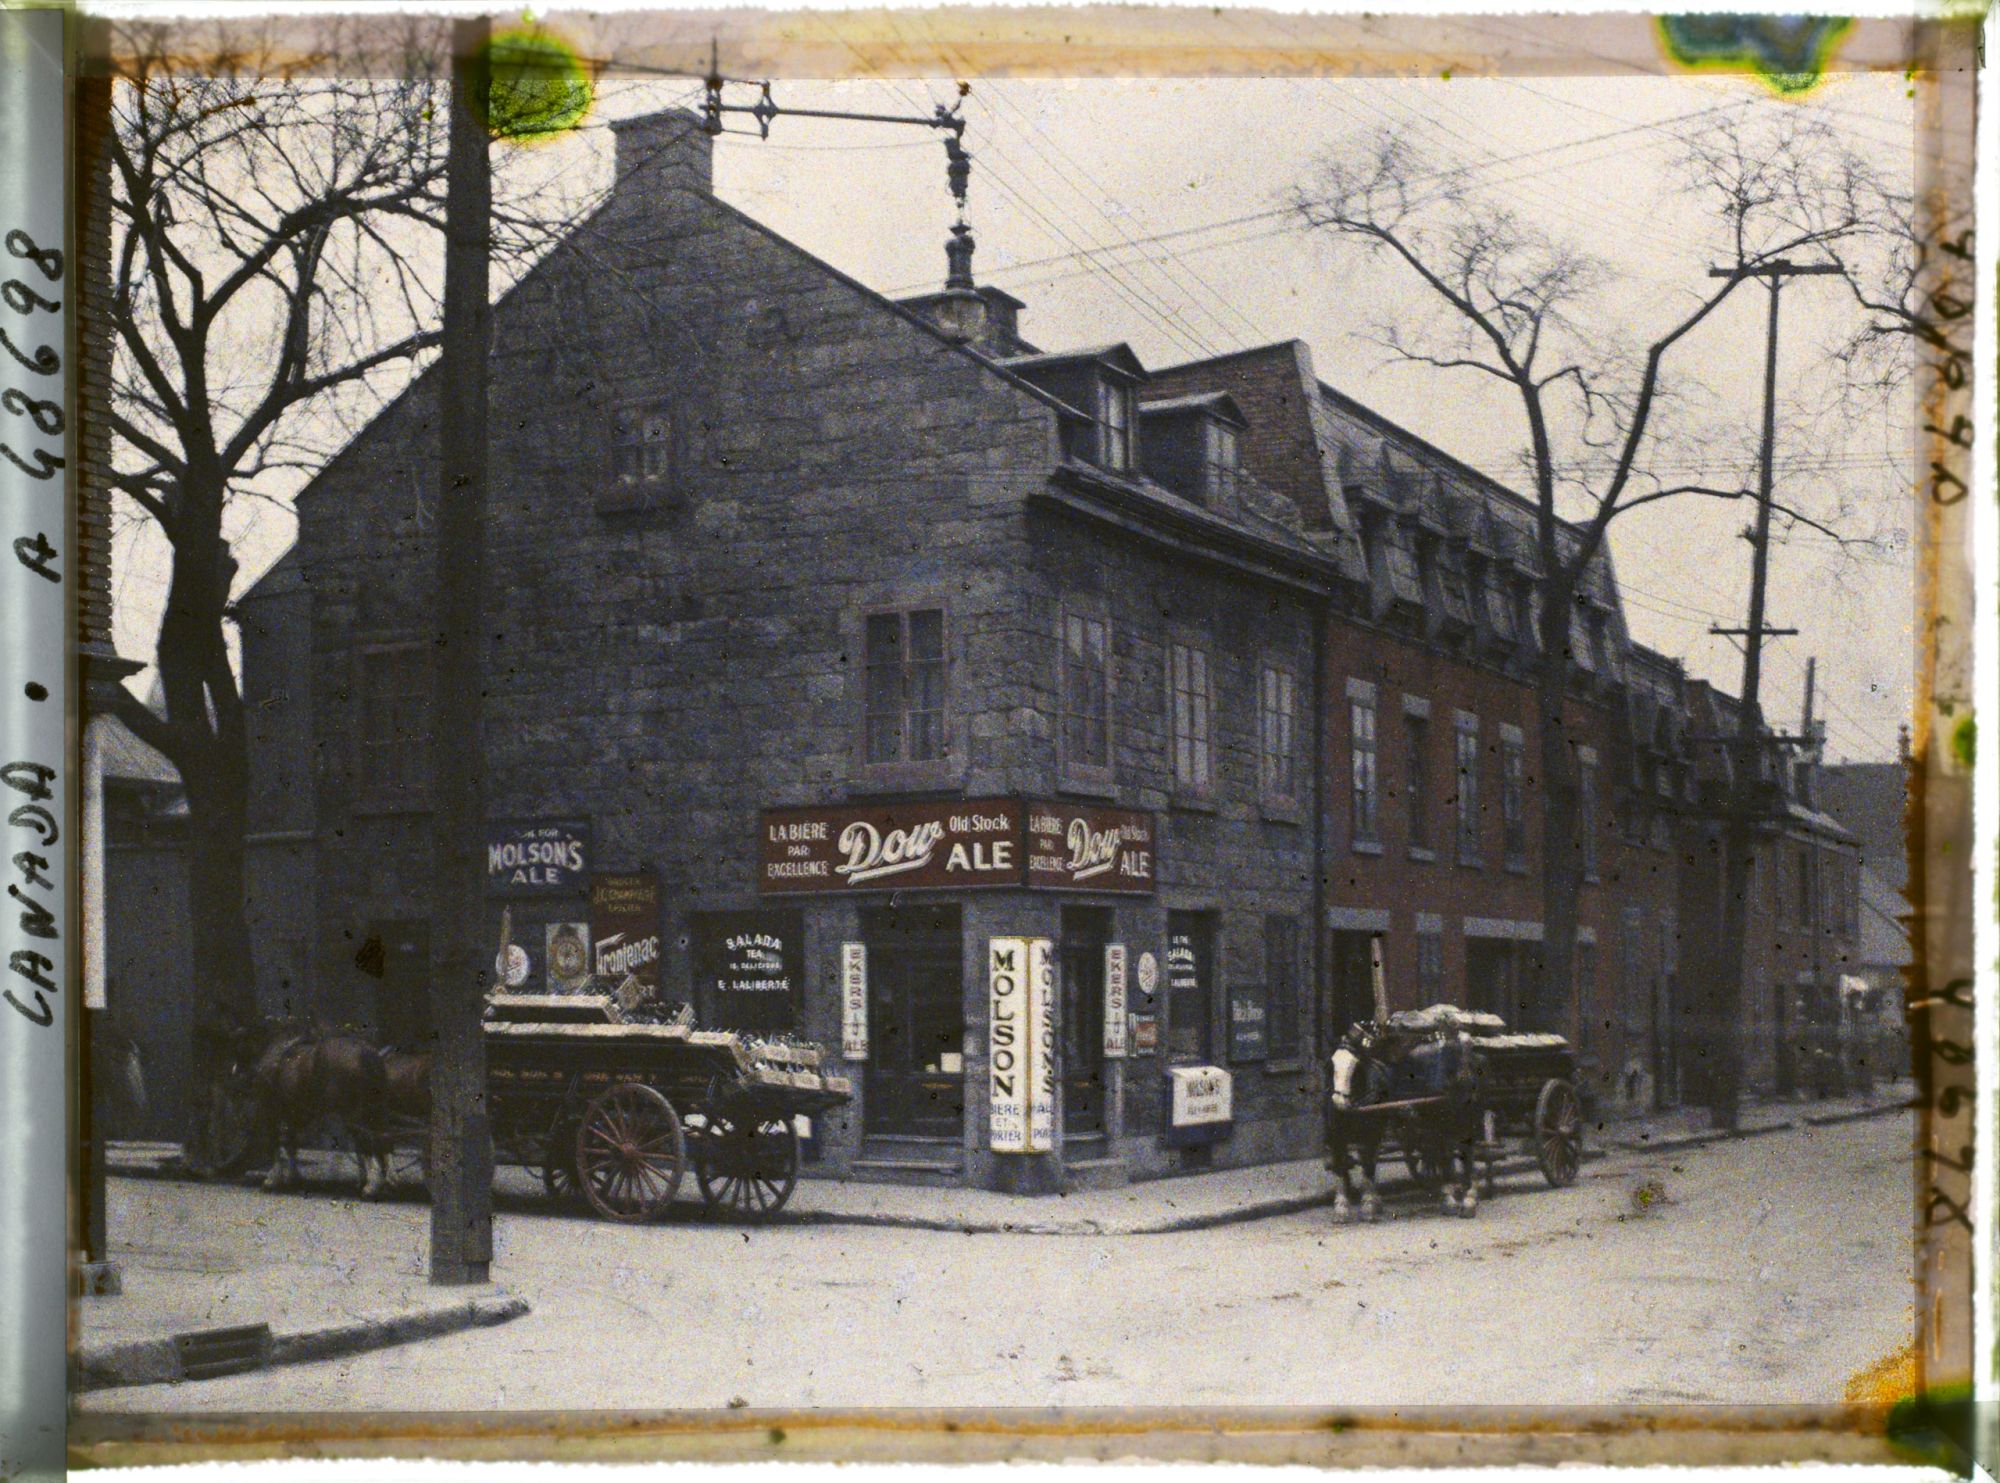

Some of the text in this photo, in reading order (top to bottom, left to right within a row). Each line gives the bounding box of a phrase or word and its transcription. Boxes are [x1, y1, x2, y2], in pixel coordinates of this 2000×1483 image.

[0, 229, 66, 1028] CANADA A 48698
[949, 812, 1011, 832] Old Stock
[769, 824, 786, 842] LA
[788, 845, 810, 857] PAR
[834, 821, 946, 875] Dow
[1067, 818, 1121, 871] Dow
[945, 840, 1015, 873] ALE
[1120, 850, 1151, 878] ALE
[510, 867, 561, 885] ALE
[767, 860, 830, 878] EXCELLENCE
[725, 933, 783, 951] SALADA
[746, 949, 764, 961] TEA
[992, 950, 1015, 1097] MOLSON
